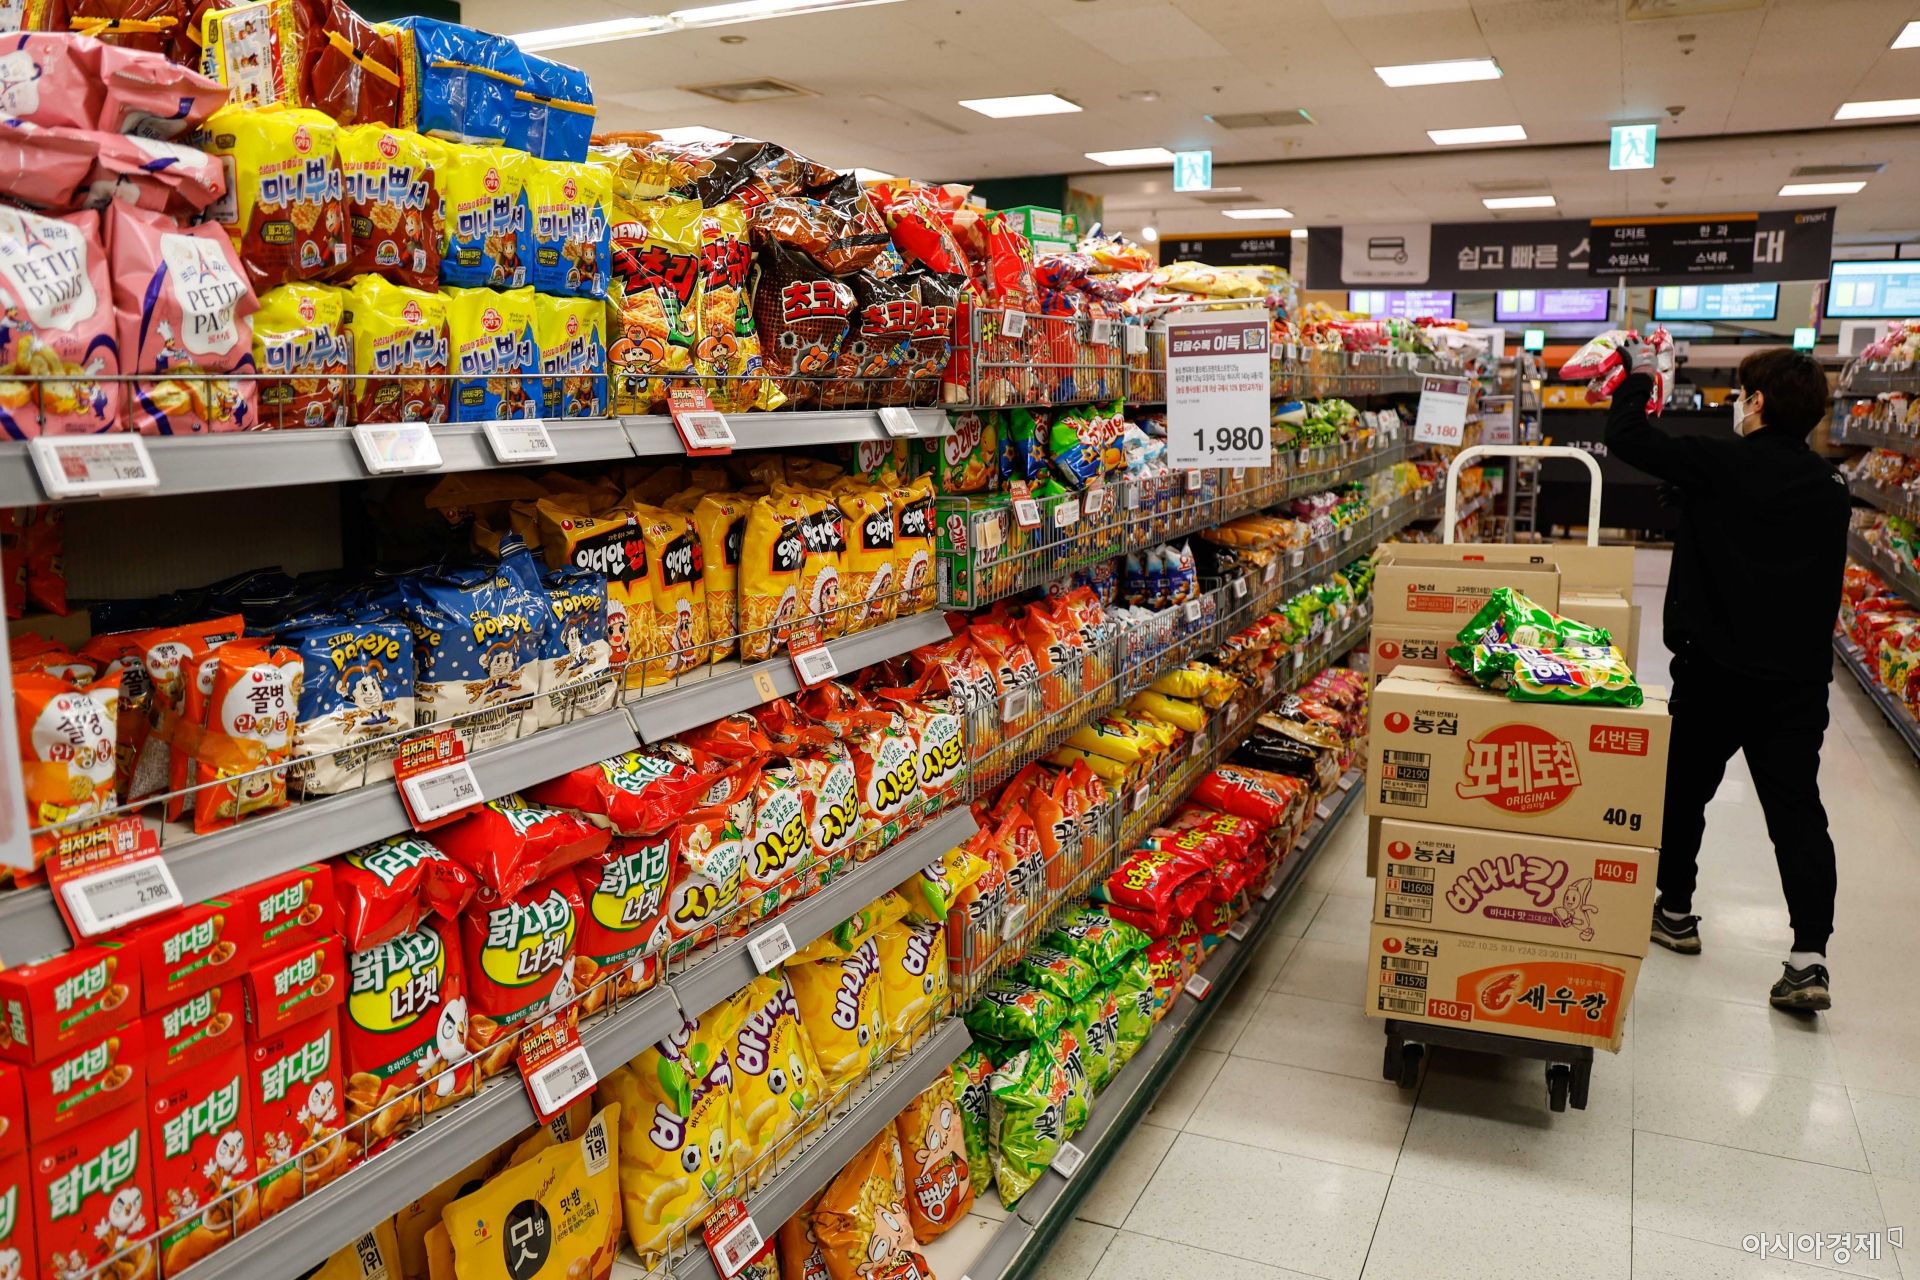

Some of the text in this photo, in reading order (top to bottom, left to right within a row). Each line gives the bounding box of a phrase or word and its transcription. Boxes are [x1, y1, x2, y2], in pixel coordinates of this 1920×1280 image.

[261, 157, 342, 208] 미니뿌셔
[458, 194, 525, 239] 미니뿌셔
[538, 205, 601, 242] 미니뿌셔
[1615, 228, 1647, 239] 디저트
[12, 246, 81, 284] PETIT
[1458, 245, 1503, 270] 쉽고
[1511, 244, 1558, 269] 빠른
[1608, 253, 1649, 265] 수입스낵
[1696, 252, 1728, 263] 스낵류
[28, 274, 83, 307] PARIS
[186, 281, 240, 312] PETIT
[265, 325, 348, 374] 미니뿌셔
[374, 329, 448, 374] 미니뿌셔
[460, 332, 532, 374] 미니뿌셔
[543, 336, 598, 374] 미니뿌셔
[1213, 335, 1240, 351] 이득
[1193, 427, 1264, 455] 1,980
[1424, 422, 1457, 438] 3,180
[574, 519, 595, 529] 농심
[576, 539, 646, 577] 인디안밥
[550, 590, 570, 600] STAR
[1418, 583, 1435, 592] 농심
[469, 612, 491, 621] STAR
[328, 633, 355, 648] STAR
[1401, 645, 1438, 660] 농심
[246, 684, 285, 714] 쫄병
[1413, 716, 1458, 735] 농심
[1416, 709, 1458, 719] 스낵은 언제나
[402, 737, 434, 758] 최저가격
[1593, 730, 1646, 752] 4번들
[1456, 739, 1583, 800] 포테토칩
[453, 783, 474, 797] 2,560
[1506, 791, 1557, 807] ORIGINAL
[761, 793, 787, 820] 달콤하게
[1520, 801, 1546, 811] 오리지널
[1603, 808, 1642, 830] 40 g
[599, 839, 670, 898] 닭다리
[706, 845, 735, 874] 달콤하게
[1414, 846, 1456, 865] 농심
[1445, 853, 1569, 914] 바나나킥
[1597, 863, 1635, 882] 140 g
[258, 880, 304, 923] 닭다리
[621, 883, 663, 924] 너겟
[1490, 908, 1516, 920] 바나나
[1517, 911, 1526, 921] 맛
[486, 889, 570, 950] 닭다리
[163, 916, 214, 965] 닭다리
[1404, 942, 1438, 957] 농심
[1458, 940, 1499, 951] 2022.10.25
[350, 923, 441, 995] 닭다리
[516, 931, 567, 979] 너겟
[54, 959, 107, 1013] 닭다리
[273, 951, 316, 996] 닭다리
[389, 965, 441, 1020] 너겟
[1517, 984, 1607, 1021] 새우깡
[162, 990, 211, 1039] 닭다리
[1431, 1002, 1470, 1021] 180 g
[51, 1041, 109, 1095] 닭다리
[261, 1028, 332, 1103] 닭다리
[387, 1048, 425, 1074] 후라이드 치킨
[571, 1067, 589, 1084] 2,380
[163, 1074, 240, 1160] 닭다리
[584, 1122, 604, 1144] 판매
[587, 1139, 607, 1161] 1위
[49, 1128, 139, 1221] 닭다리
[559, 1187, 581, 1215] 맛밤
